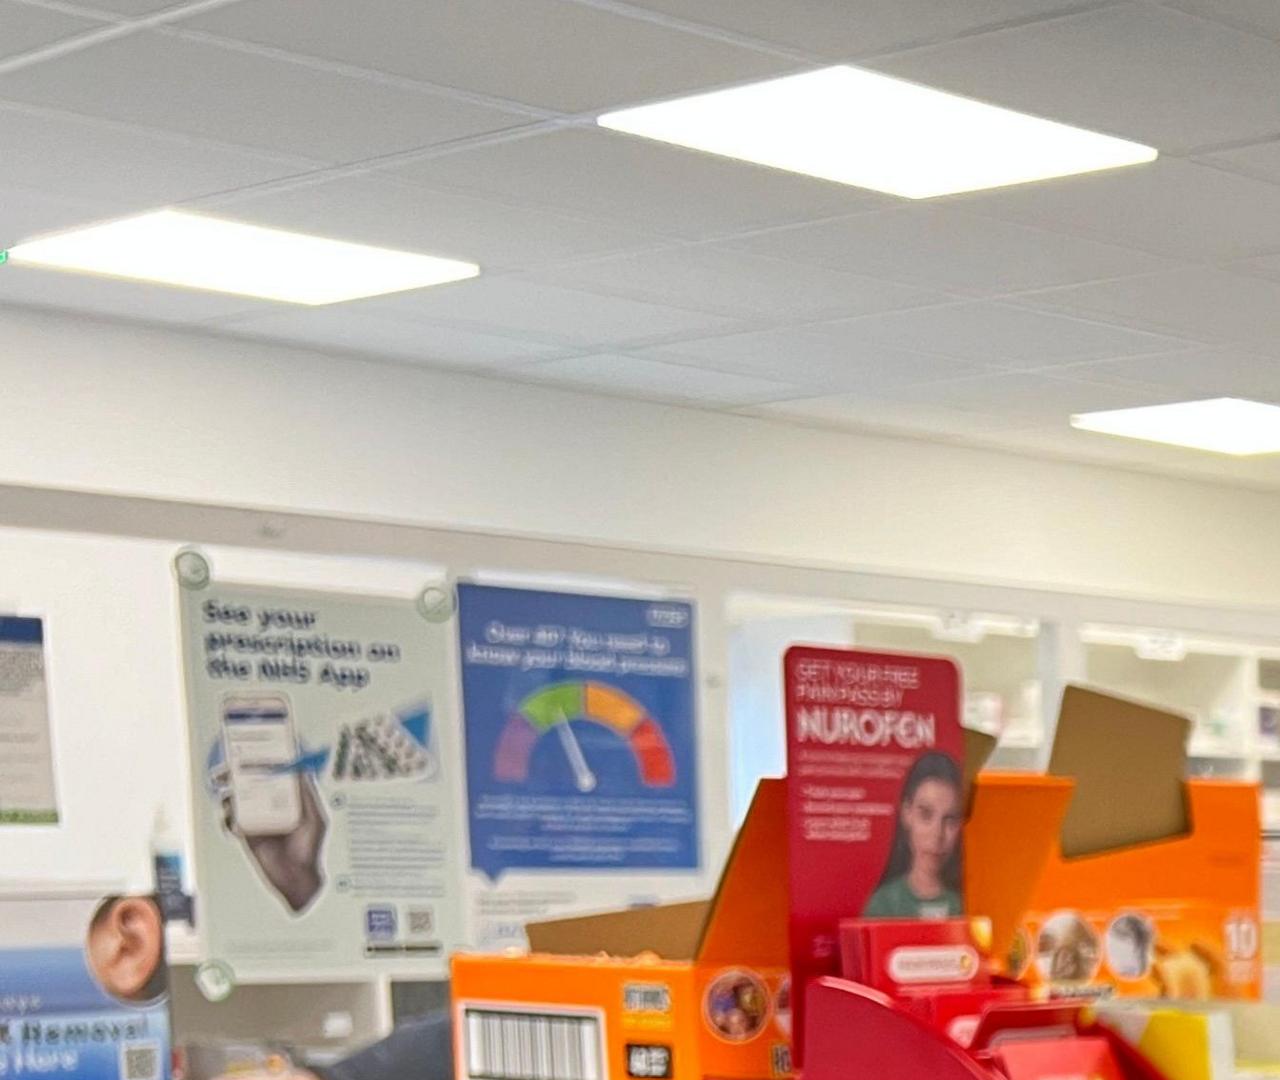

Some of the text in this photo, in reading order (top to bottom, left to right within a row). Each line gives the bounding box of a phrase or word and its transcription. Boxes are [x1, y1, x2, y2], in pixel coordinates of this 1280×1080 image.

[203, 599, 317, 632] See your
[205, 632, 401, 662] prescription on
[207, 653, 251, 679] the
[319, 663, 370, 692] App
[797, 706, 935, 748] NUROFEN
